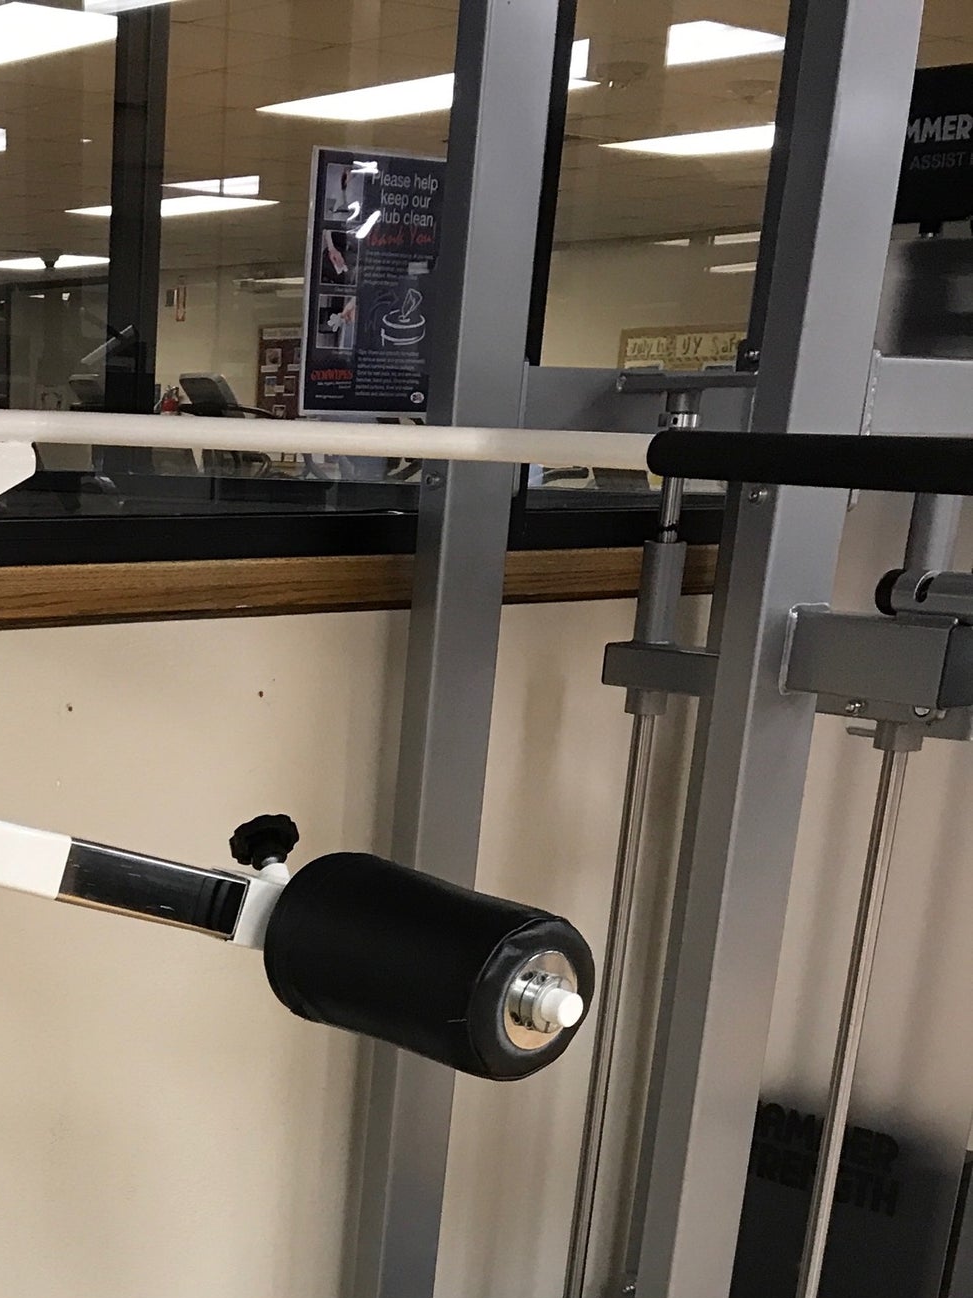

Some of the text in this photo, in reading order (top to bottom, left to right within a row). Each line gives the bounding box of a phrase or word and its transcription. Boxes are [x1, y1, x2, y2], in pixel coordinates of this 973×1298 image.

[909, 152, 965, 170] ASSIST
[371, 169, 438, 194] Please help
[381, 188, 431, 209] keep our
[403, 209, 434, 227] clean
[712, 333, 738, 355] Saf
